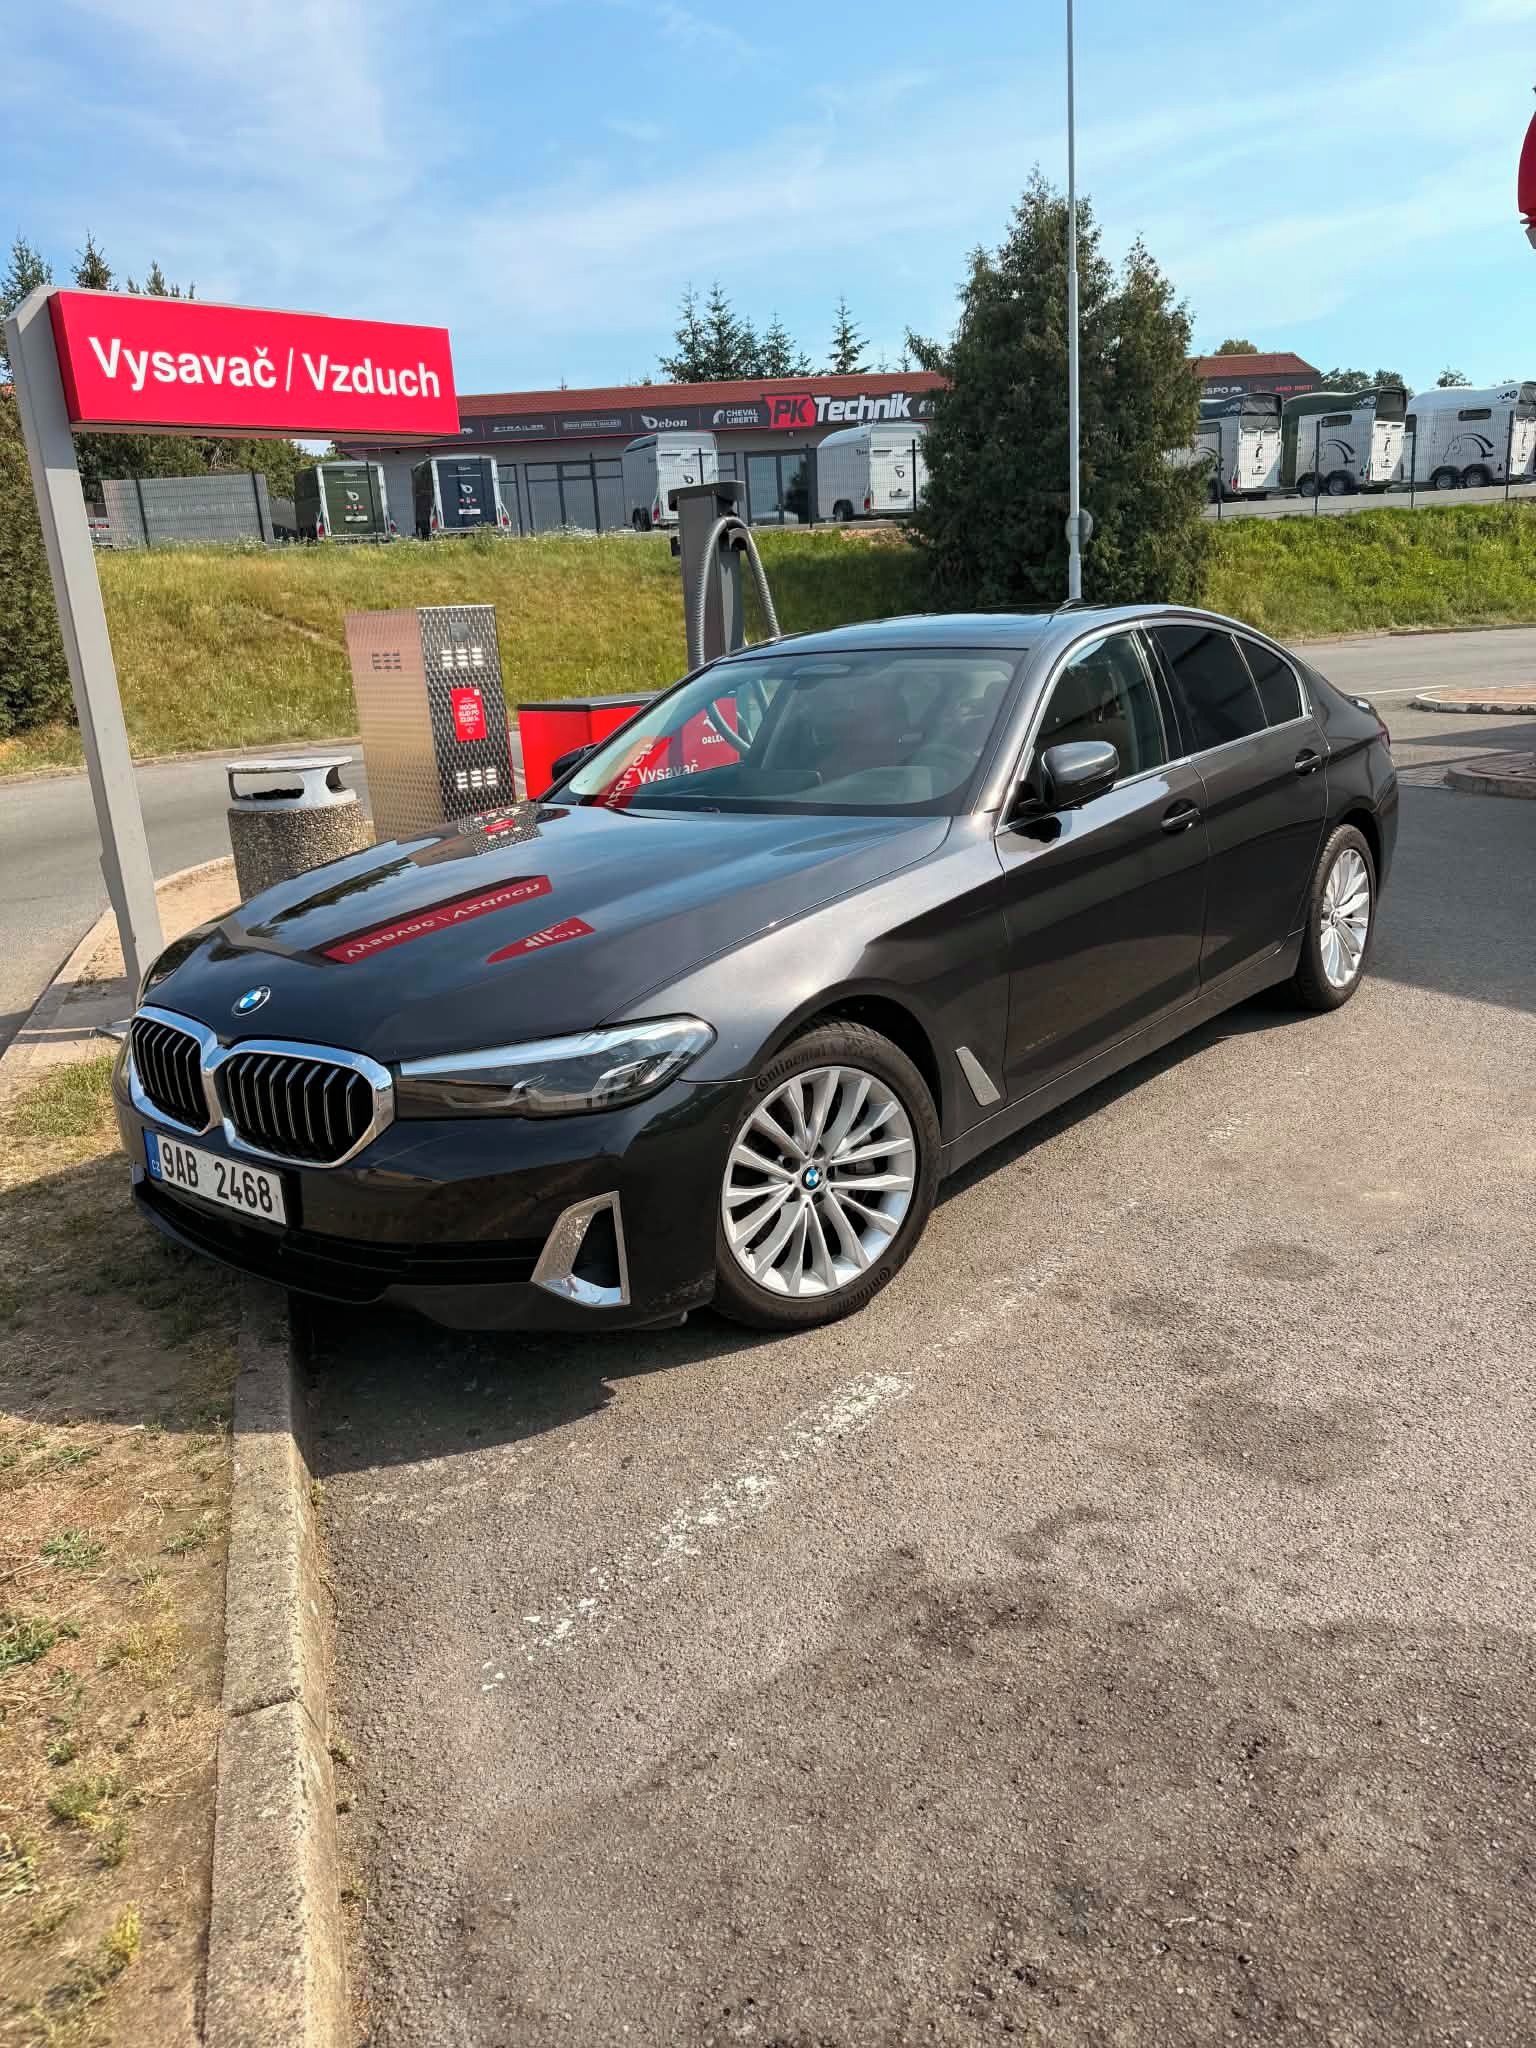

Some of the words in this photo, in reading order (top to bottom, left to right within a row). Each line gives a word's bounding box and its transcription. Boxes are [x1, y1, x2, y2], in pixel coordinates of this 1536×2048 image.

[88, 336, 277, 392] Vysavač
[285, 347, 294, 392] /
[302, 352, 441, 398] Vzduch
[726, 408, 758, 417] CHEVAL
[773, 399, 808, 424] PK
[814, 393, 912, 422] Technik
[151, 1159, 161, 1172] CZ
[162, 1142, 199, 1188] 9AB
[214, 1161, 273, 1213] 2468
